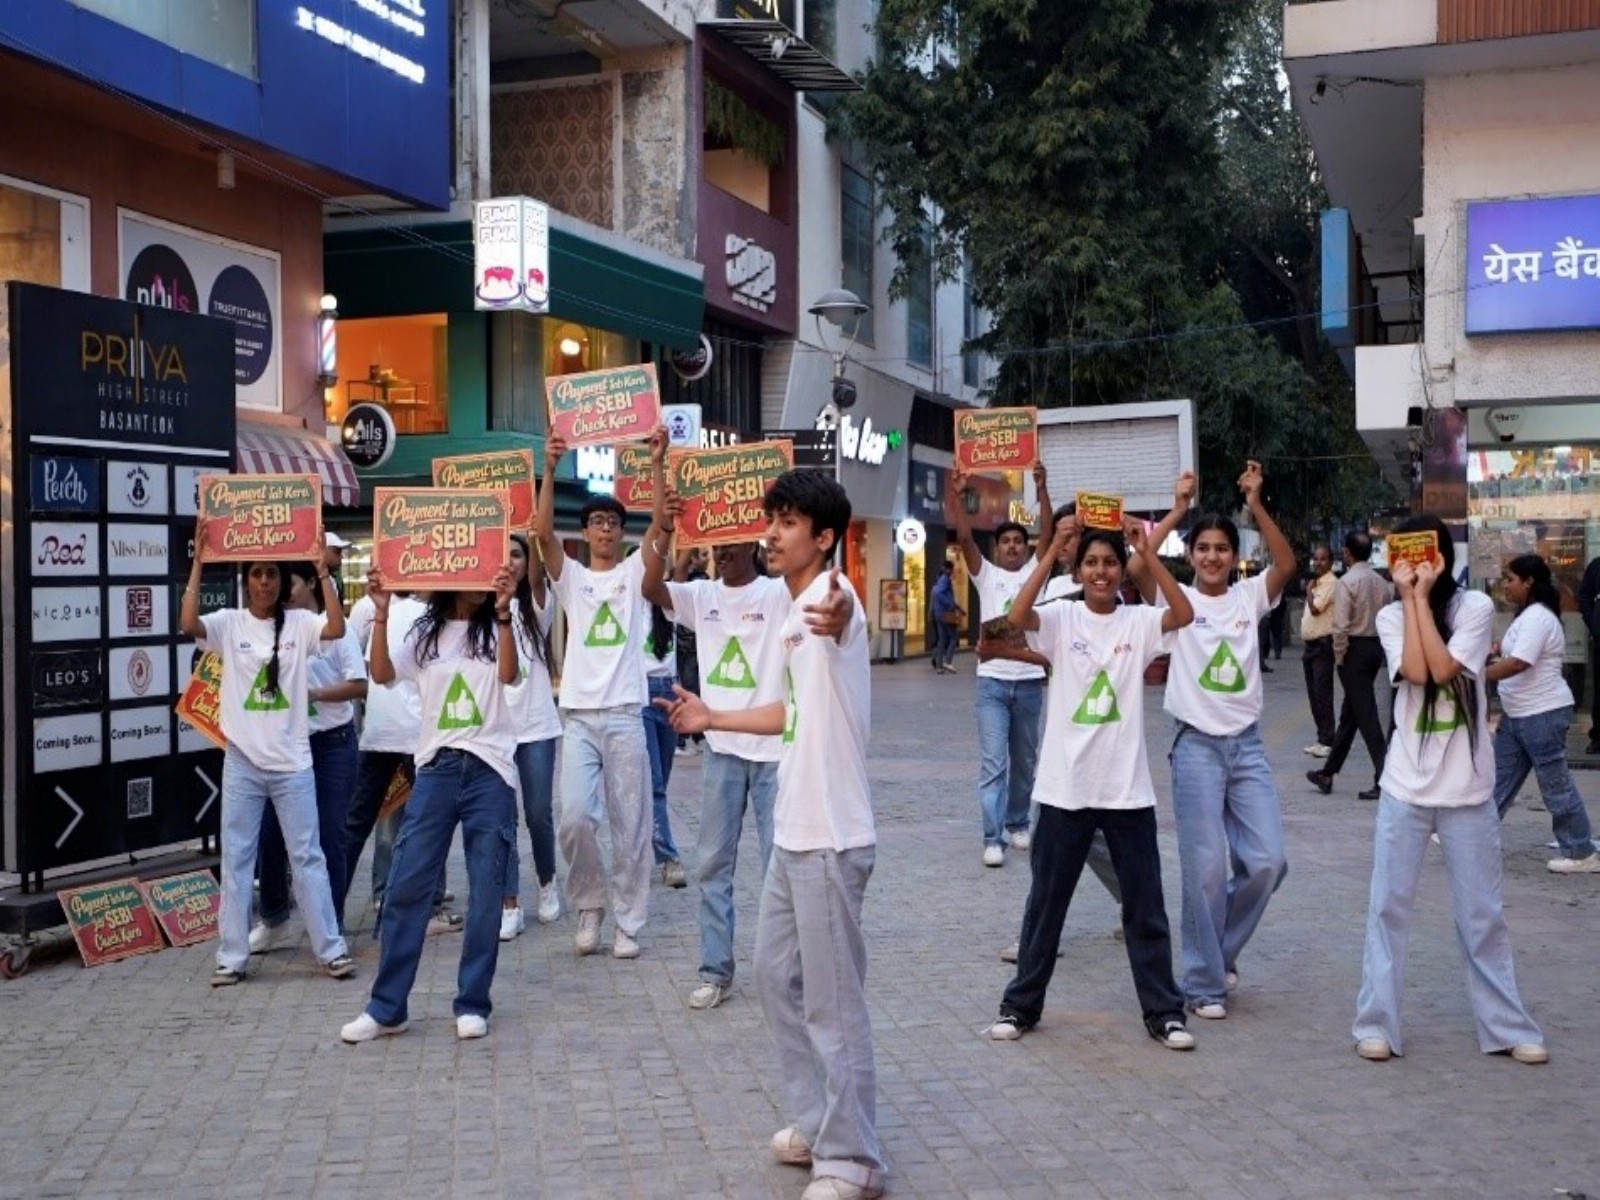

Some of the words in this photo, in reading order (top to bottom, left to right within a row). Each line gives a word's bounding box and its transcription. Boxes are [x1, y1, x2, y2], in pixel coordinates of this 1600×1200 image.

[1483, 243, 1543, 282] येस
[98, 381, 132, 399] HIGH
[144, 387, 189, 407] STREET
[557, 378, 608, 403] Payment
[596, 391, 632, 414] SEBI
[100, 410, 149, 432] BASANT
[152, 416, 175, 434] LOK
[572, 417, 607, 437] Check
[609, 413, 637, 429] Karo
[990, 428, 1018, 448] SEBI
[43, 460, 88, 504] Perch
[681, 456, 738, 487] Payment
[211, 482, 266, 508] Payment
[724, 475, 765, 505] SEBI
[252, 503, 291, 527] SEBI
[386, 496, 449, 528] Payment
[451, 503, 468, 518] Tab
[697, 507, 736, 531] Check
[739, 504, 765, 525] Kar
[223, 528, 261, 549] Check
[264, 527, 295, 546] Karo
[431, 522, 475, 550] SEBI
[38, 533, 87, 565] Red
[110, 540, 137, 558] Miss
[399, 551, 441, 575] Check
[443, 551, 478, 572] Karo
[45, 669, 90, 687] LEO'S
[36, 737, 70, 751] Coming
[111, 728, 142, 740] Coming
[185, 894, 211, 914] SEBI
[105, 905, 134, 929] SEBI
